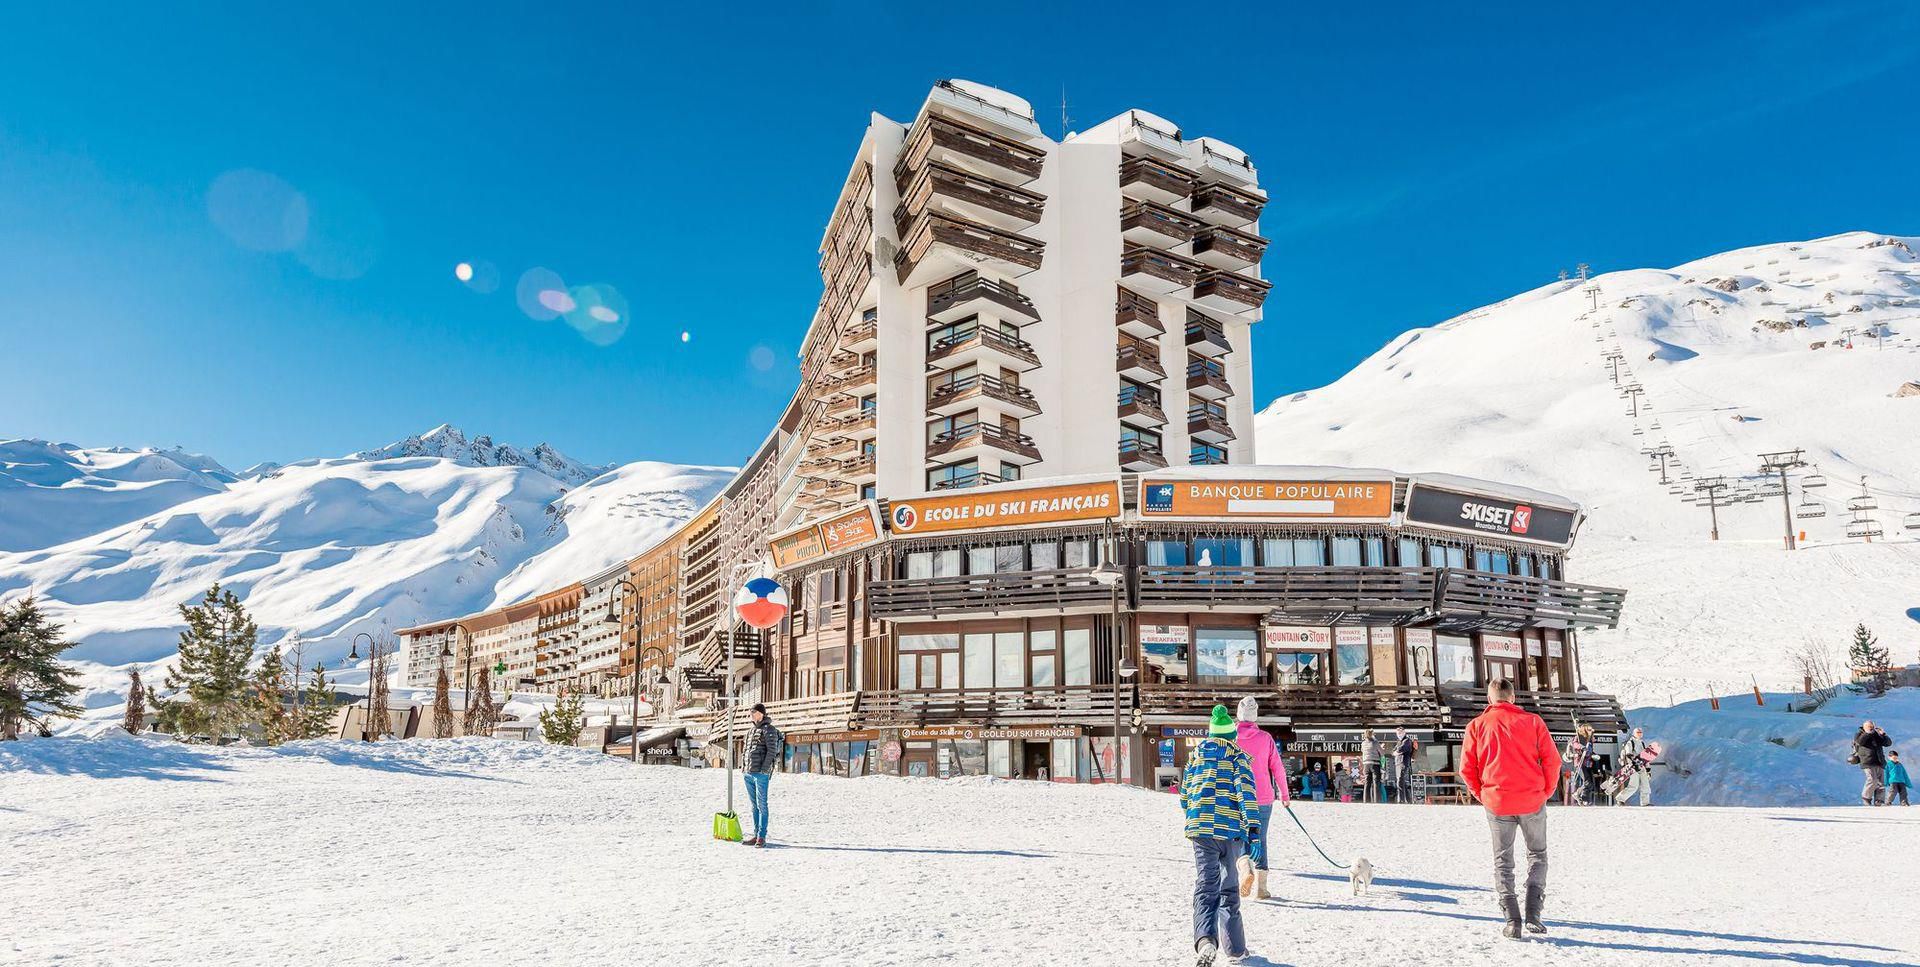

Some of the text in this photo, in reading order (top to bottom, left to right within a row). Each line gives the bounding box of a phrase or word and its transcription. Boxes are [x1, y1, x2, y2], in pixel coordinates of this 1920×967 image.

[1190, 485, 1375, 500] BANQUE POPULAIRE
[924, 493, 1110, 522] ECOLE DU SKI FRANÇAIS
[1460, 502, 1514, 526] SKISET
[1475, 521, 1510, 533] Mountain Story
[1266, 629, 1329, 644] MOUNTAIN STORY
[979, 730, 1005, 738] ECOLE
[1007, 730, 1018, 738] DU
[1173, 728, 1204, 736] BANQUE
[647, 747, 673, 756] sherpa
[1287, 741, 1308, 752] CRÊPES
[1323, 742, 1344, 752] BREAK
